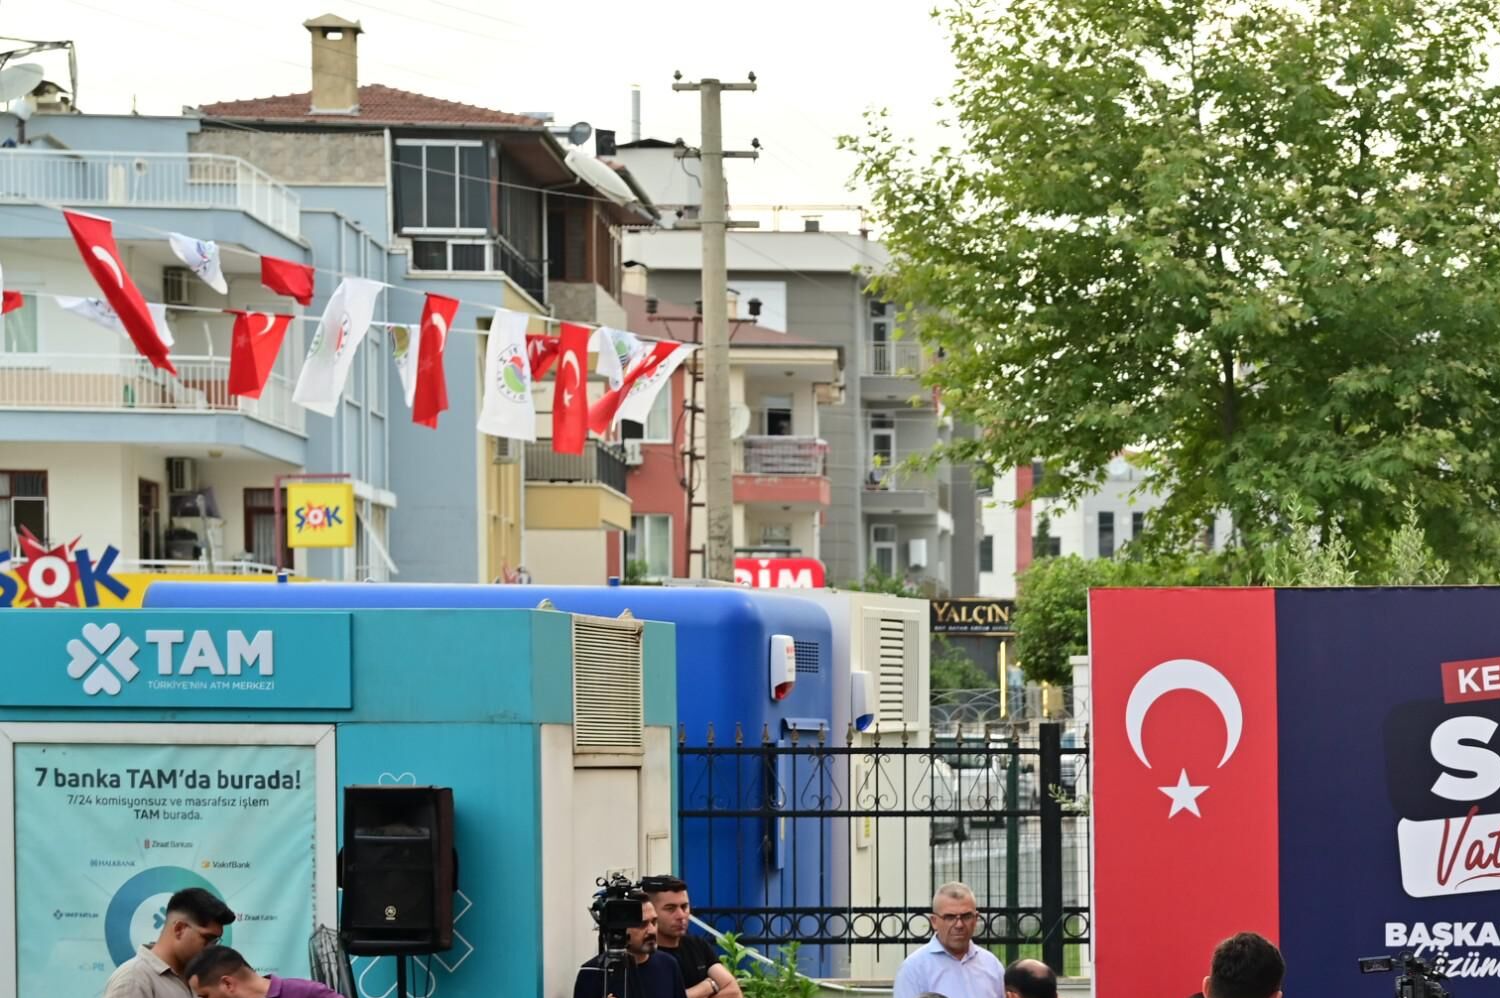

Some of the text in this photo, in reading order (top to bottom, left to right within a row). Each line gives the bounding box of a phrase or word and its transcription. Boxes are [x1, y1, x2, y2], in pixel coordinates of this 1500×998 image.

[295, 506, 342, 533] ŞOK
[932, 602, 1009, 624] YALÇIN
[145, 629, 273, 675] TAM
[209, 680, 230, 690] ATM
[232, 679, 275, 691] MERKEZİ
[35, 767, 48, 787] 7
[54, 768, 121, 788] banka
[217, 769, 301, 790] burada!
[67, 795, 269, 809] 7/24 komisyonsuz ve masrafsız işlem
[134, 809, 203, 820] TAM burada.
